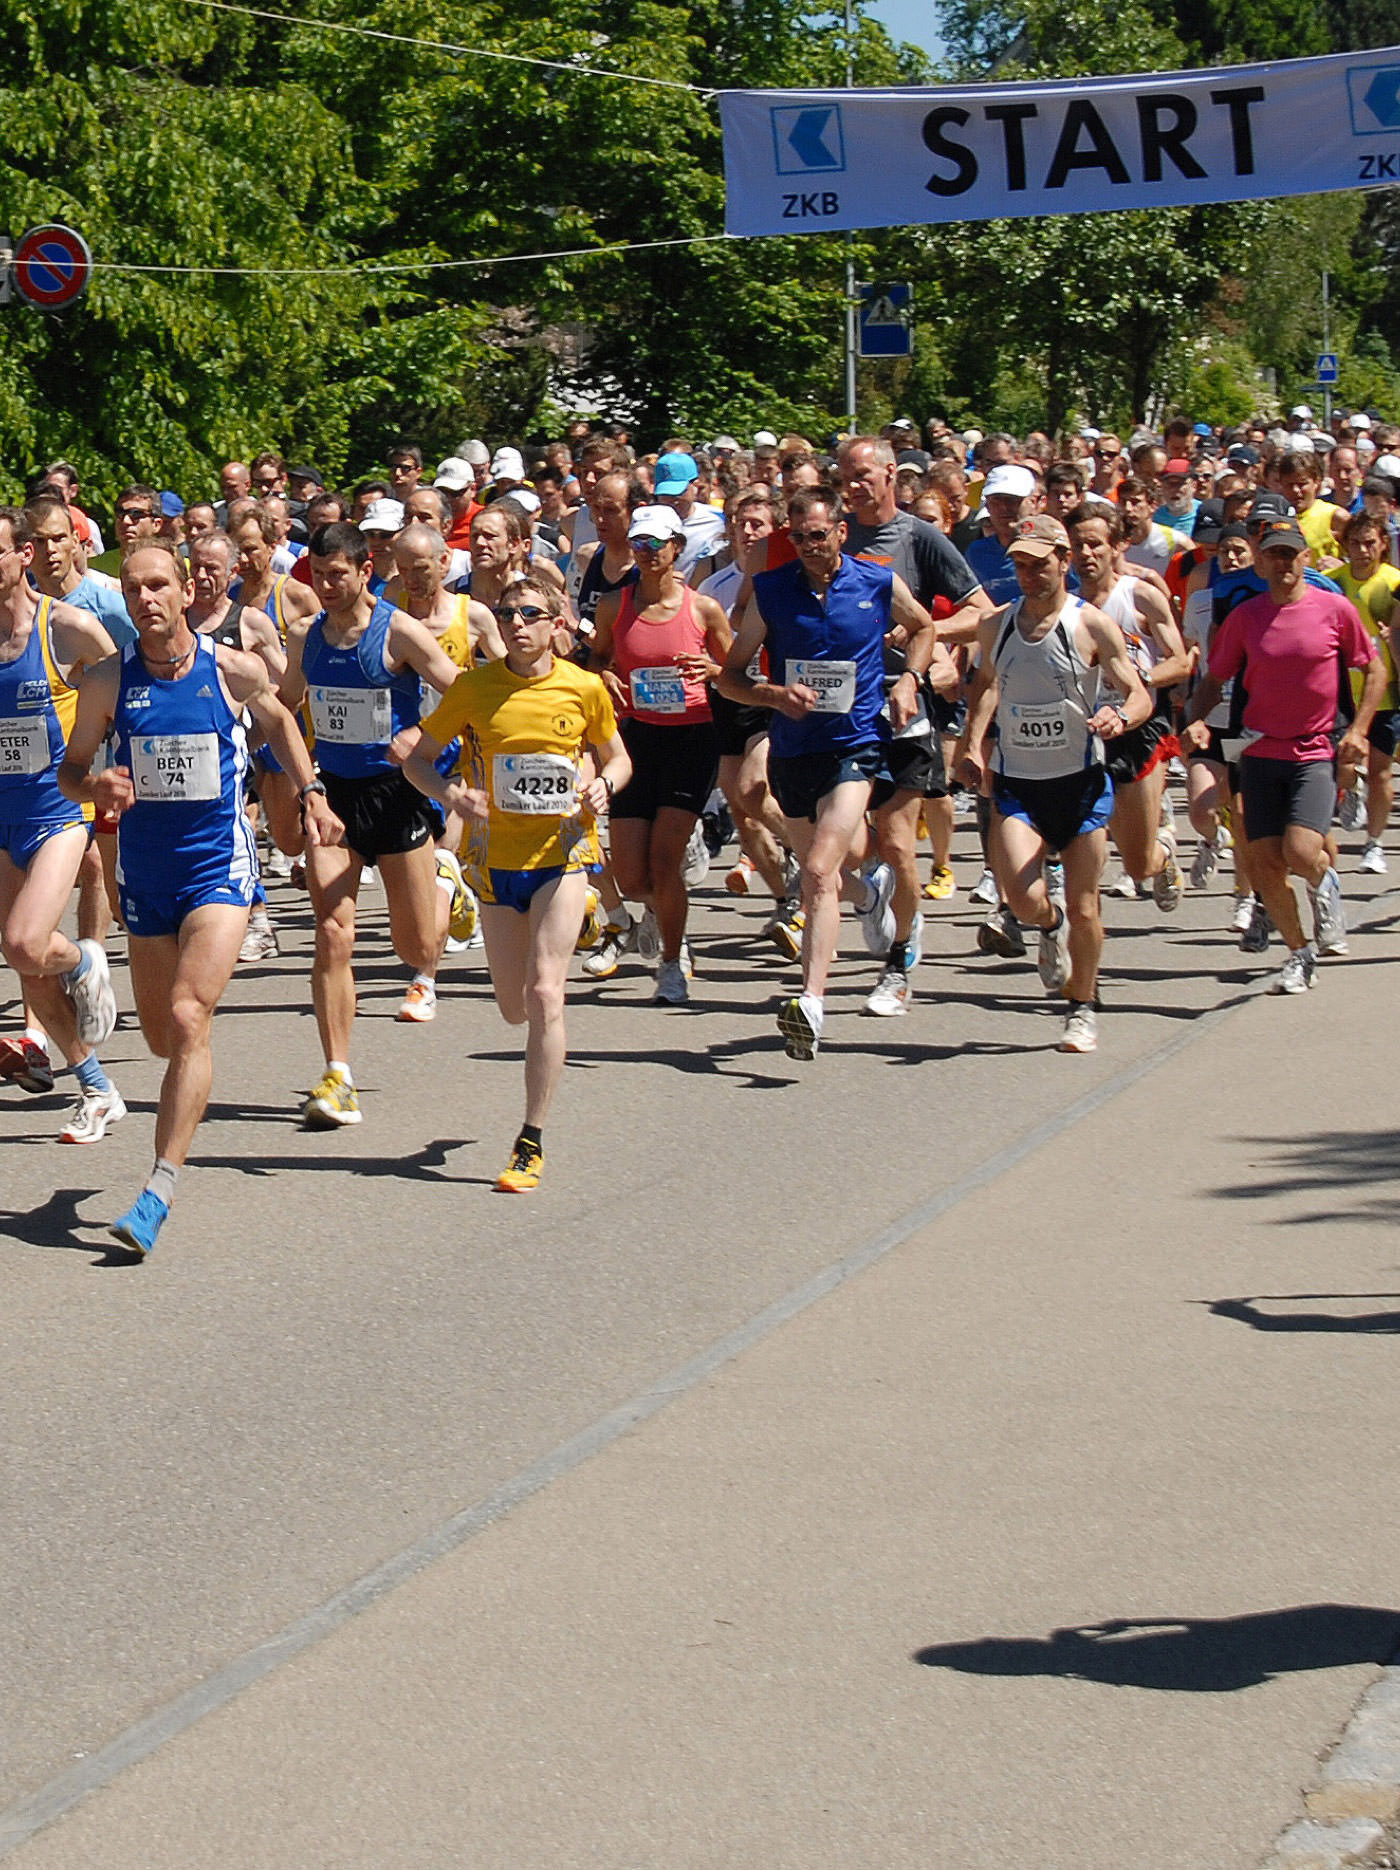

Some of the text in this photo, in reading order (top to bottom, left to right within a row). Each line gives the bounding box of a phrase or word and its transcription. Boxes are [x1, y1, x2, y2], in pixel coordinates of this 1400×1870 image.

[922, 86, 1265, 197] START
[1358, 153, 1400, 180] ZK
[781, 191, 839, 218] ZKB
[798, 677, 843, 688] ALFRED
[328, 706, 347, 717] KAI
[329, 719, 344, 730] 83
[1020, 720, 1064, 737] 4019
[4, 749, 21, 761] 58
[157, 757, 194, 770] BEAT
[141, 772, 185, 786] C 74
[514, 777, 568, 795] 4228
